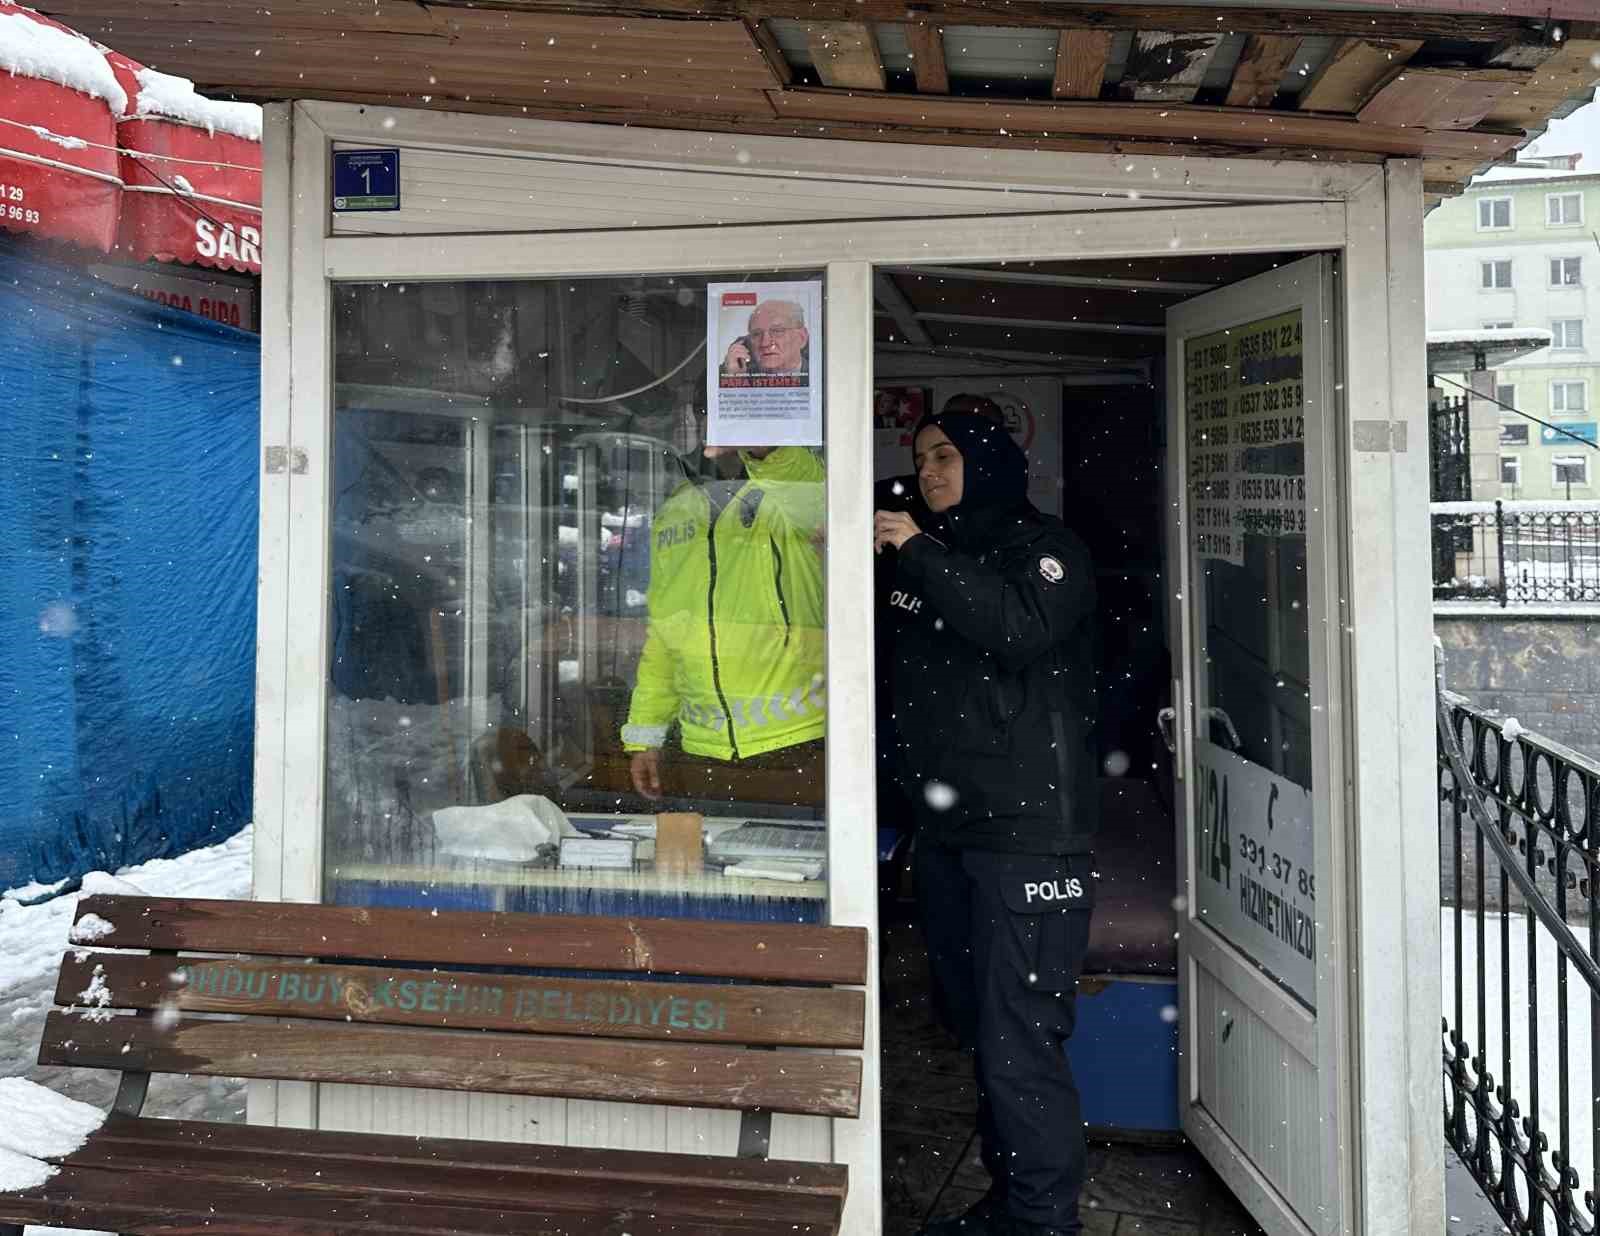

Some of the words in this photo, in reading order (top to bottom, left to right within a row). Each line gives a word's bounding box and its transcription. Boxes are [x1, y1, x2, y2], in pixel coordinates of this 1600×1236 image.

[8, 186, 24, 201] 29
[361, 167, 371, 194] 1
[8, 205, 24, 221] 96
[25, 209, 40, 225] 93
[195, 218, 262, 265] SAR
[1280, 323, 1293, 348] 22
[1294, 319, 1303, 345] 4
[1240, 391, 1261, 415] 0537
[1262, 388, 1280, 412] 382
[1281, 385, 1293, 409] 35
[1295, 384, 1303, 407] 9
[1240, 420, 1261, 442] 0535
[1263, 418, 1280, 442] 558
[1281, 415, 1294, 440] 34
[1241, 479, 1263, 500] 0535
[1264, 479, 1281, 500] 834
[1282, 478, 1294, 500] 17
[1271, 851, 1293, 885] 37
[1239, 868, 1317, 968] HİZMETİNİZD
